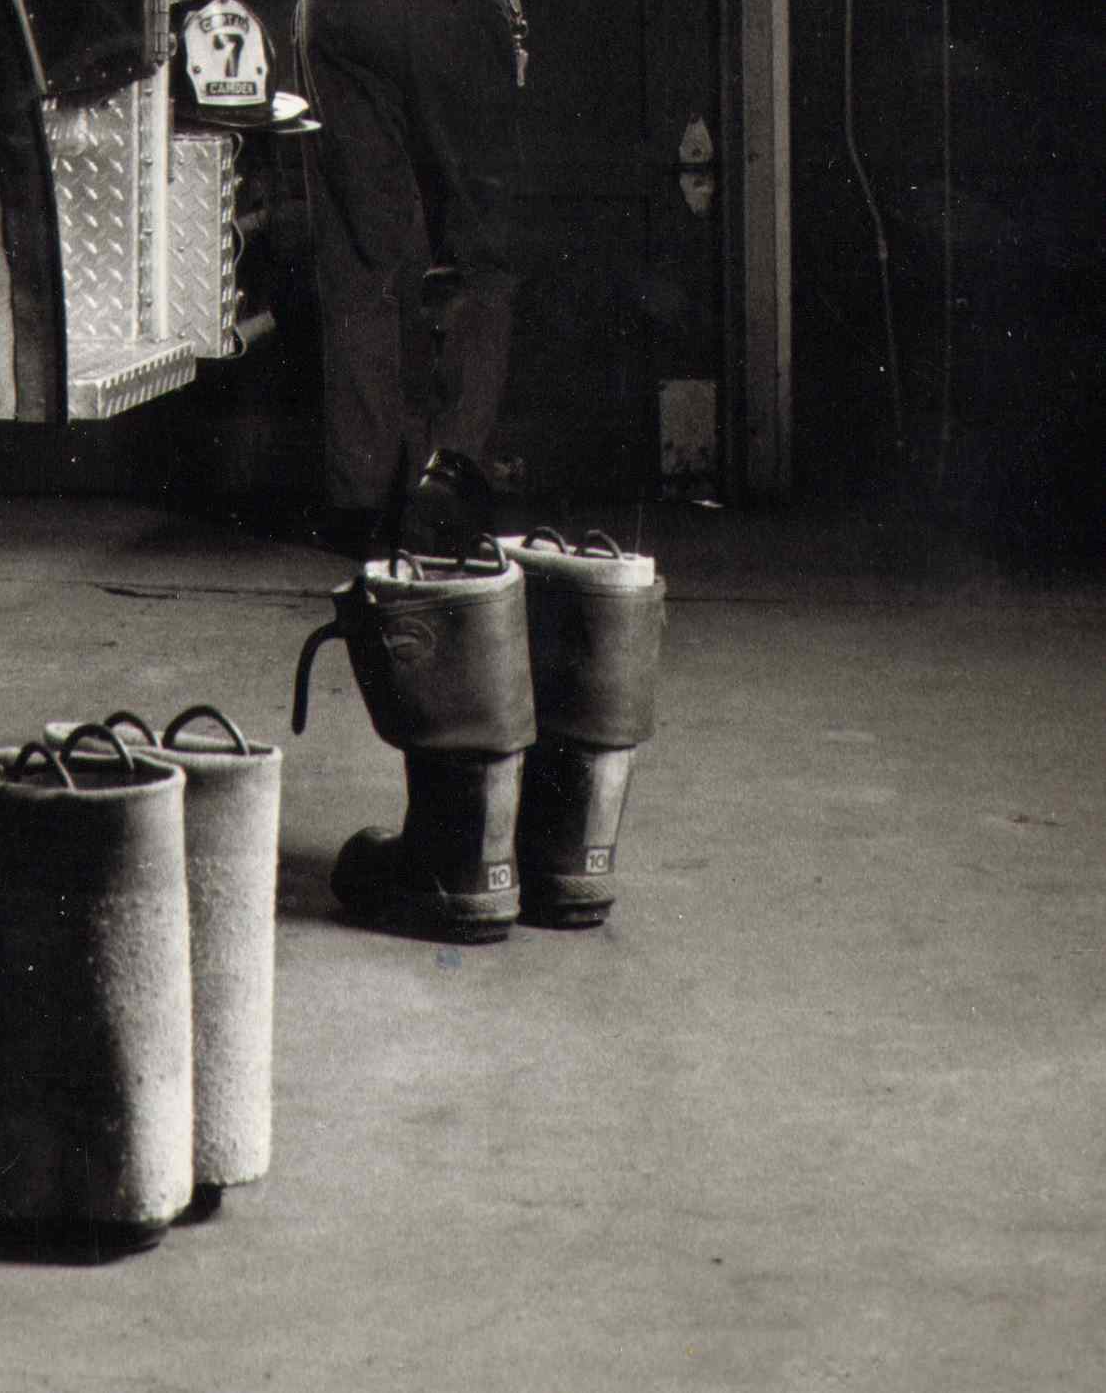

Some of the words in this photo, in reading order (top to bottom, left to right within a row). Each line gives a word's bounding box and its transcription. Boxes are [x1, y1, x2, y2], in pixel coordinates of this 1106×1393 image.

[213, 33, 244, 77] 7
[589, 853, 607, 870] 10
[491, 868, 508, 886] 10
